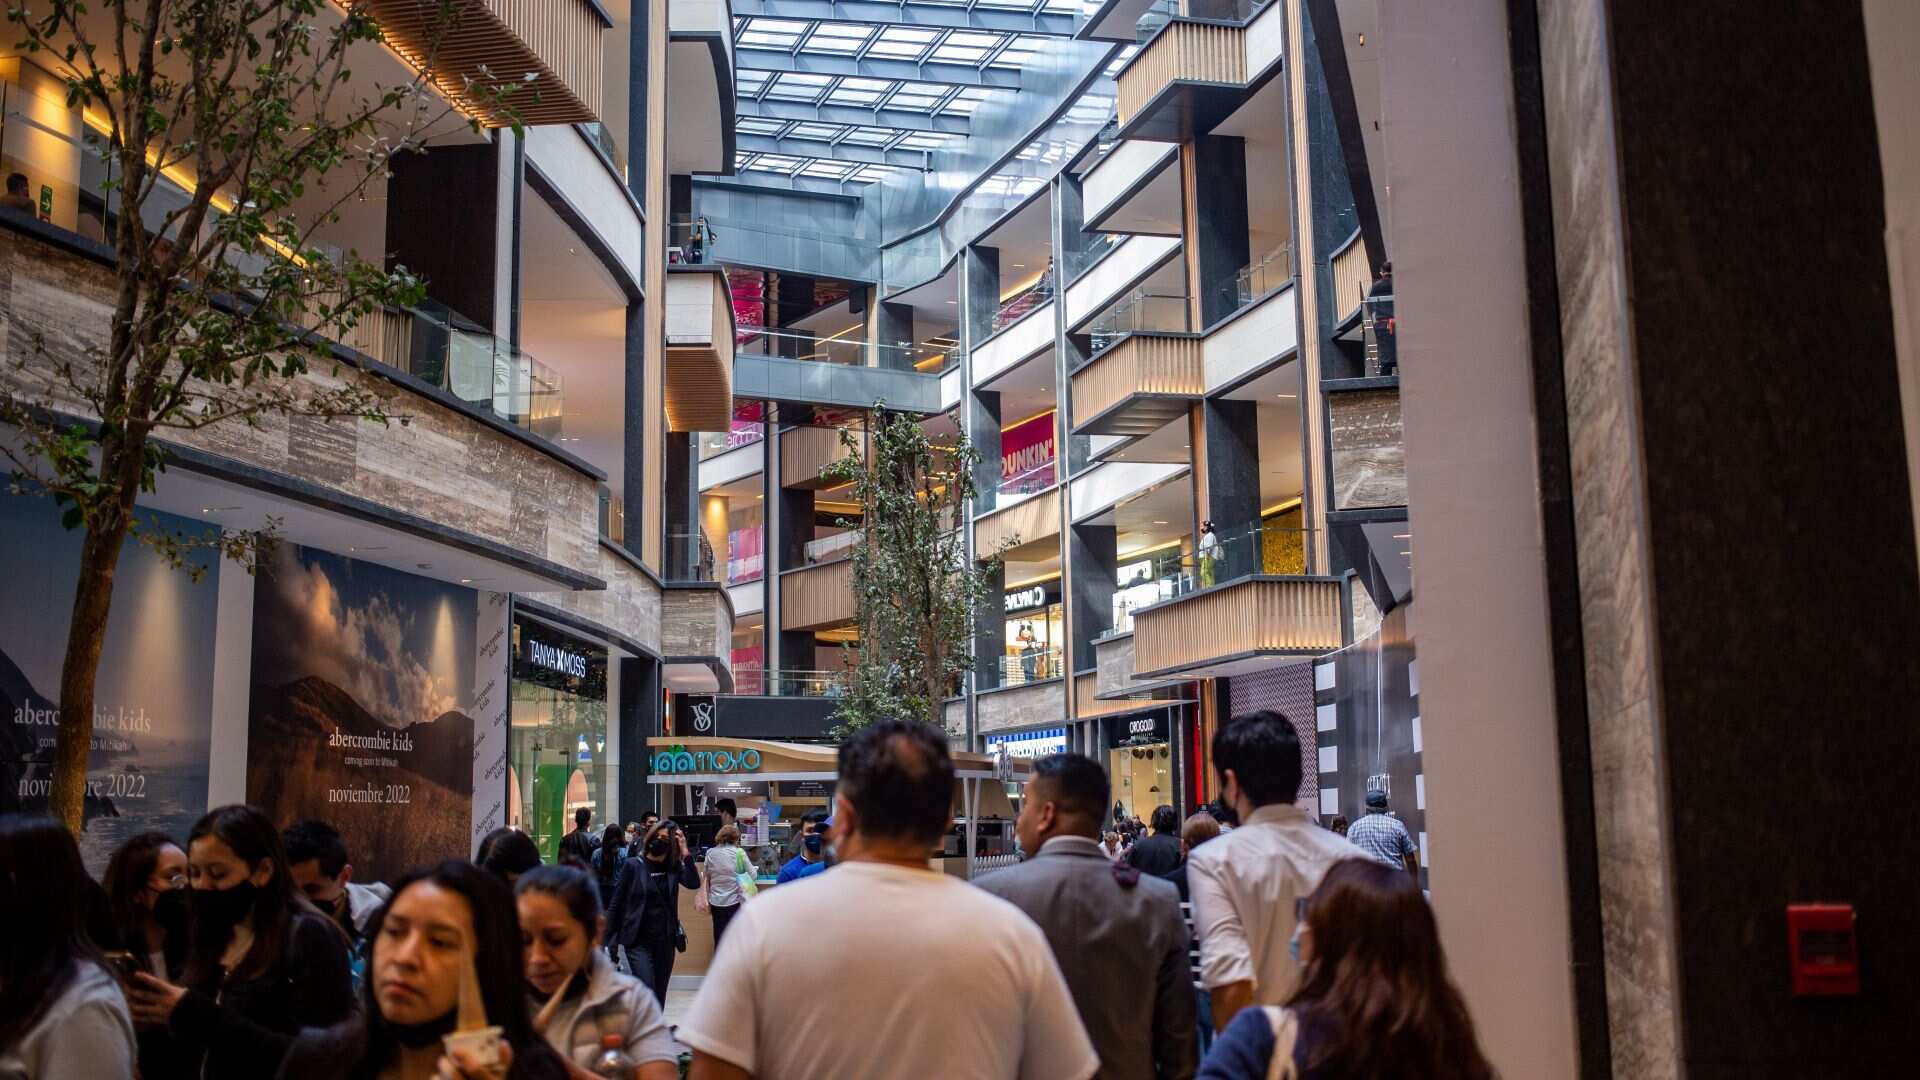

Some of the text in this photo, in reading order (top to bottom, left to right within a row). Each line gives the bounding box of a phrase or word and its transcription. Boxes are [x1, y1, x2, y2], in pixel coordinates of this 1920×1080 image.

[529, 640, 556, 670] TANYA
[564, 652, 586, 678] MOSS
[14, 698, 152, 734] abercbie kids
[329, 726, 413, 752] abercrombie kids
[18, 772, 146, 799] novire 2022
[329, 782, 410, 804] noviembre 2022
